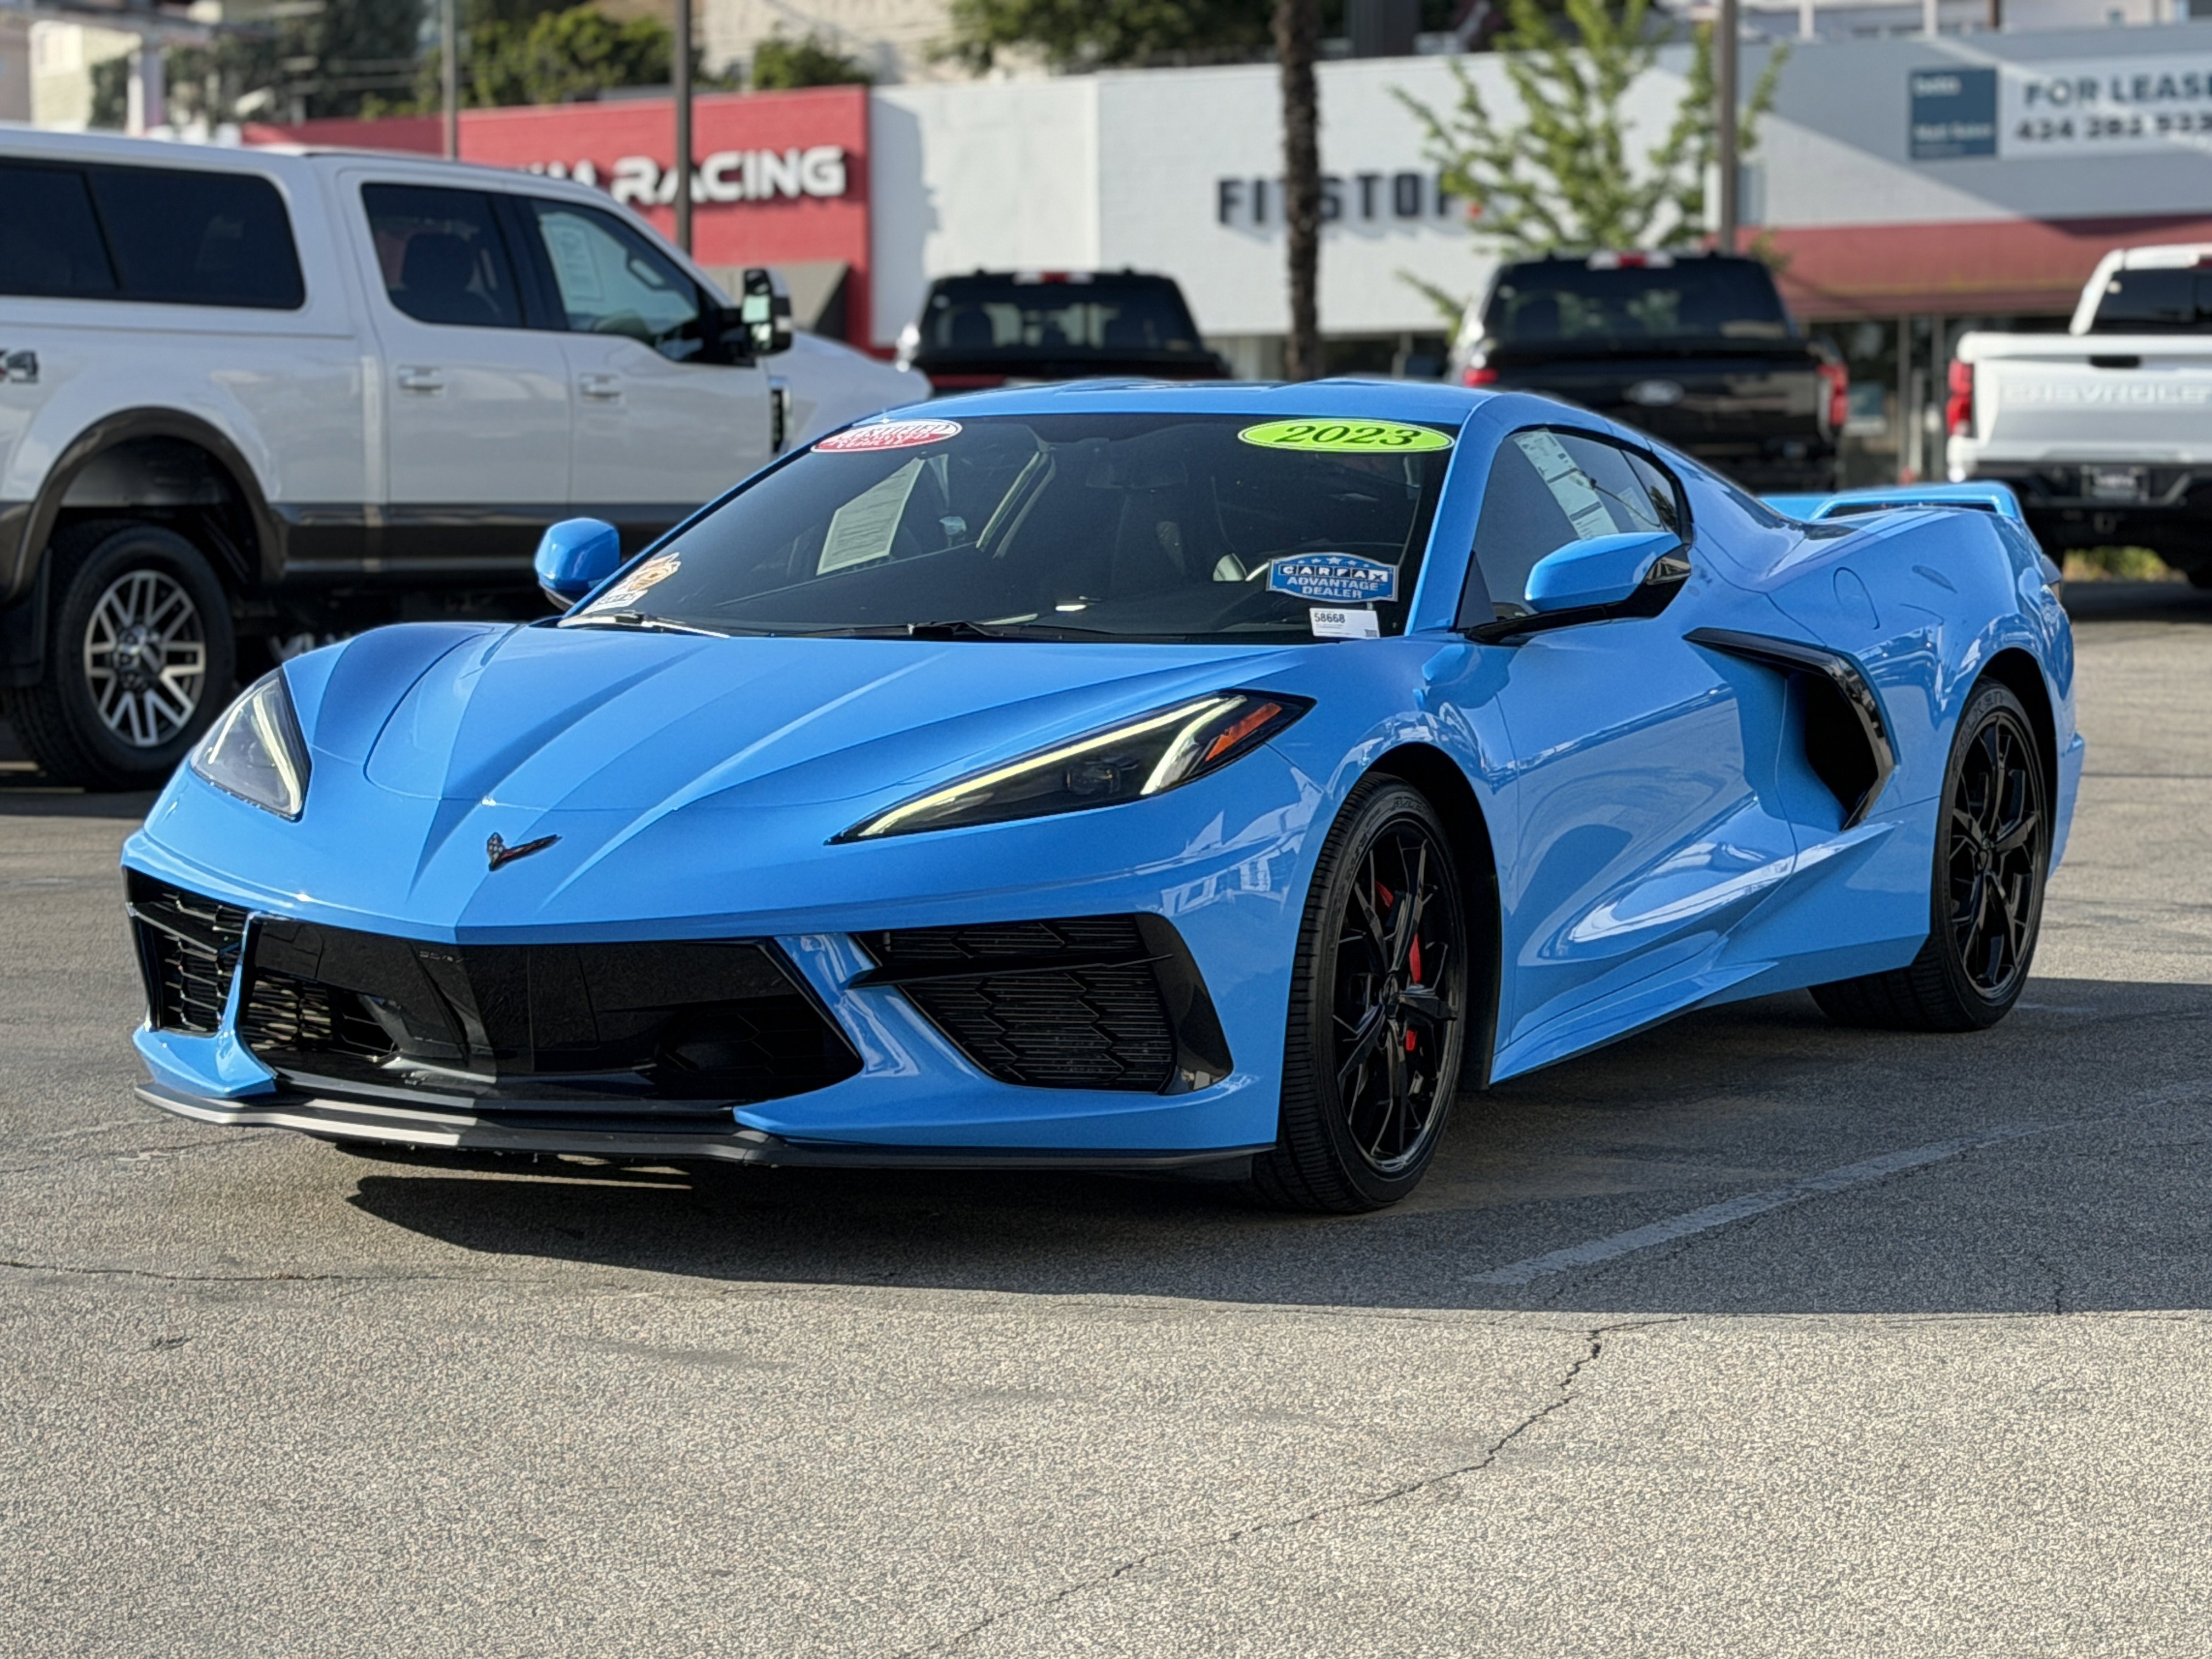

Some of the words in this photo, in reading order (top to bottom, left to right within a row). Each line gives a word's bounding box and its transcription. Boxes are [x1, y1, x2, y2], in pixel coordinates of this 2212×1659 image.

[2024, 77, 2100, 106] FOR
[611, 144, 845, 205] RACING
[1218, 173, 1460, 223] FISTO
[1274, 425, 1422, 447] 2023
[1282, 565, 1386, 582] CARFAX
[1286, 576, 1379, 591] ADVANTAGE
[1301, 586, 1363, 599] DEALER
[1314, 612, 1346, 624] 58668
